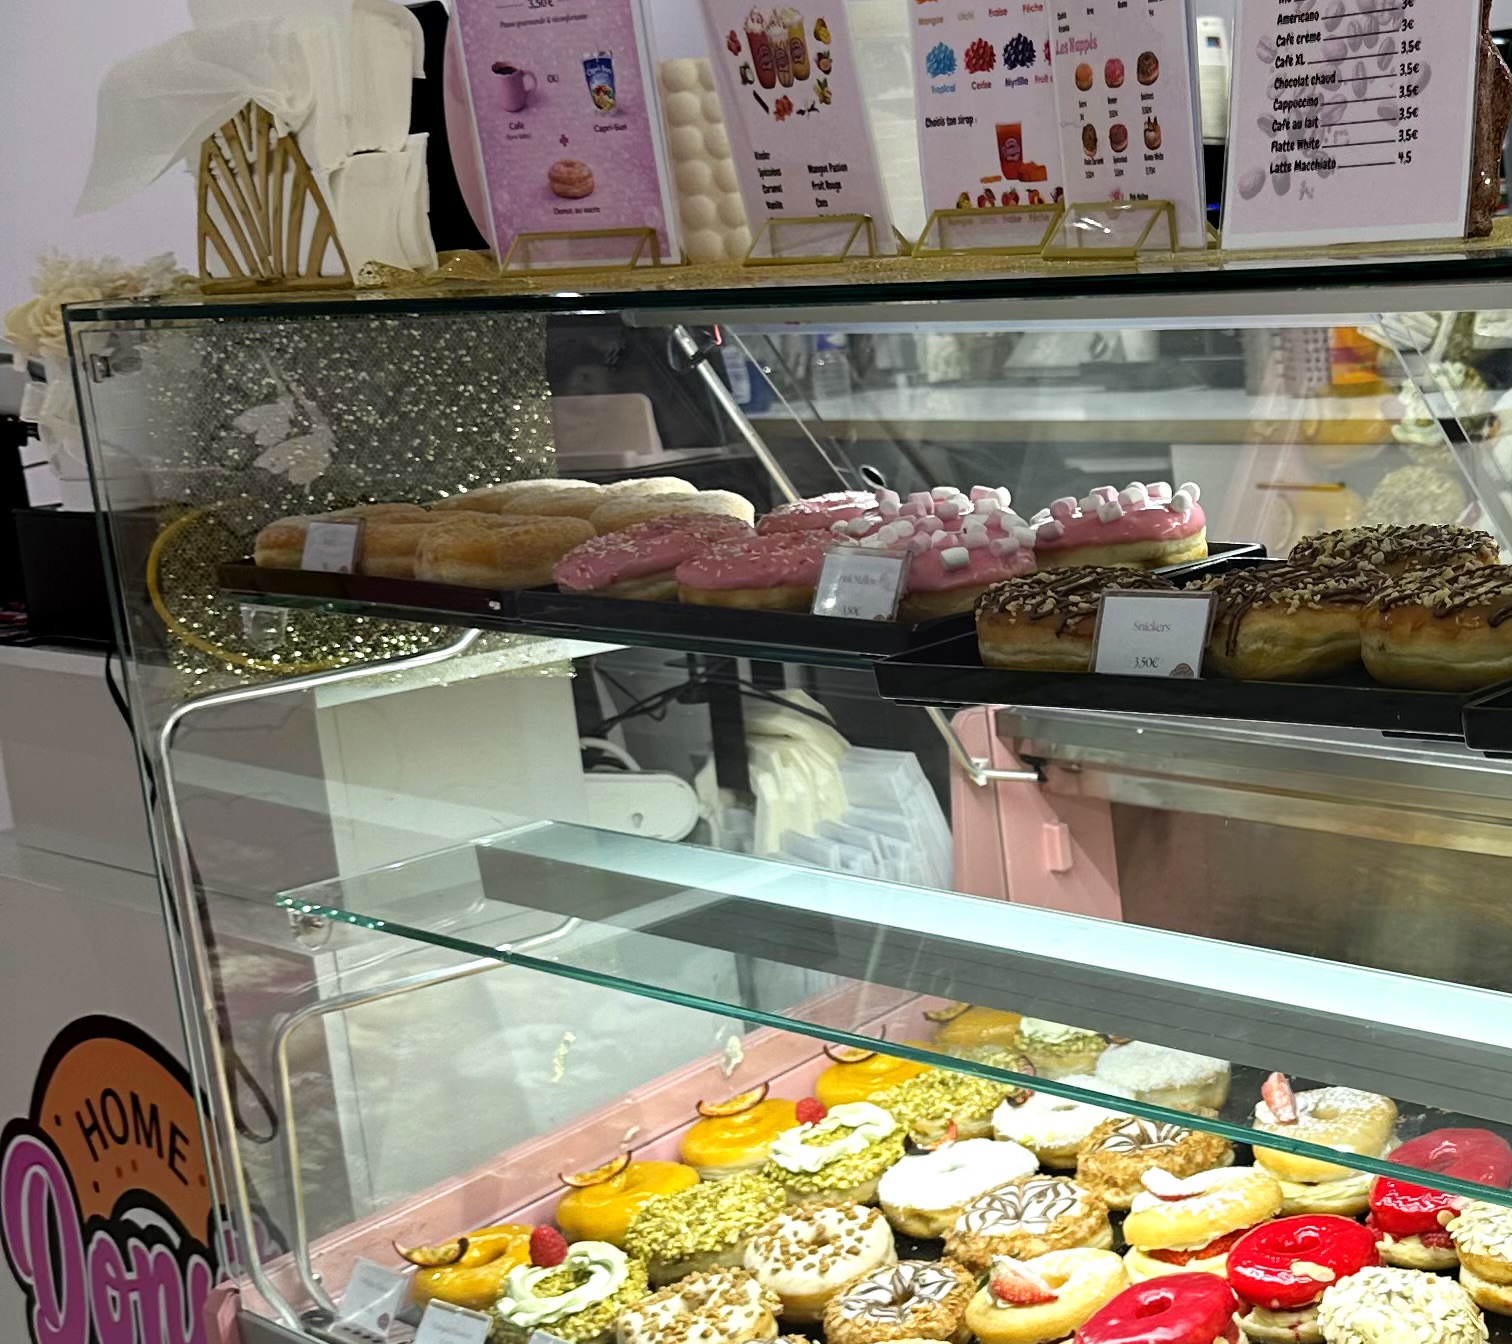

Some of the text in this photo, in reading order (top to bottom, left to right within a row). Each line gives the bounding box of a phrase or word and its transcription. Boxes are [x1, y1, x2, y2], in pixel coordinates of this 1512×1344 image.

[1277, 11, 1319, 25] Americano
[1401, 19, 1414, 32] 3€
[1295, 53, 1306, 65] XL
[971, 80, 992, 90] Cerise
[1274, 74, 1310, 90] Chocolat
[1270, 161, 1291, 175] Latte
[1133, 619, 1171, 632] Snickers
[76, 1088, 190, 1186] HOME
